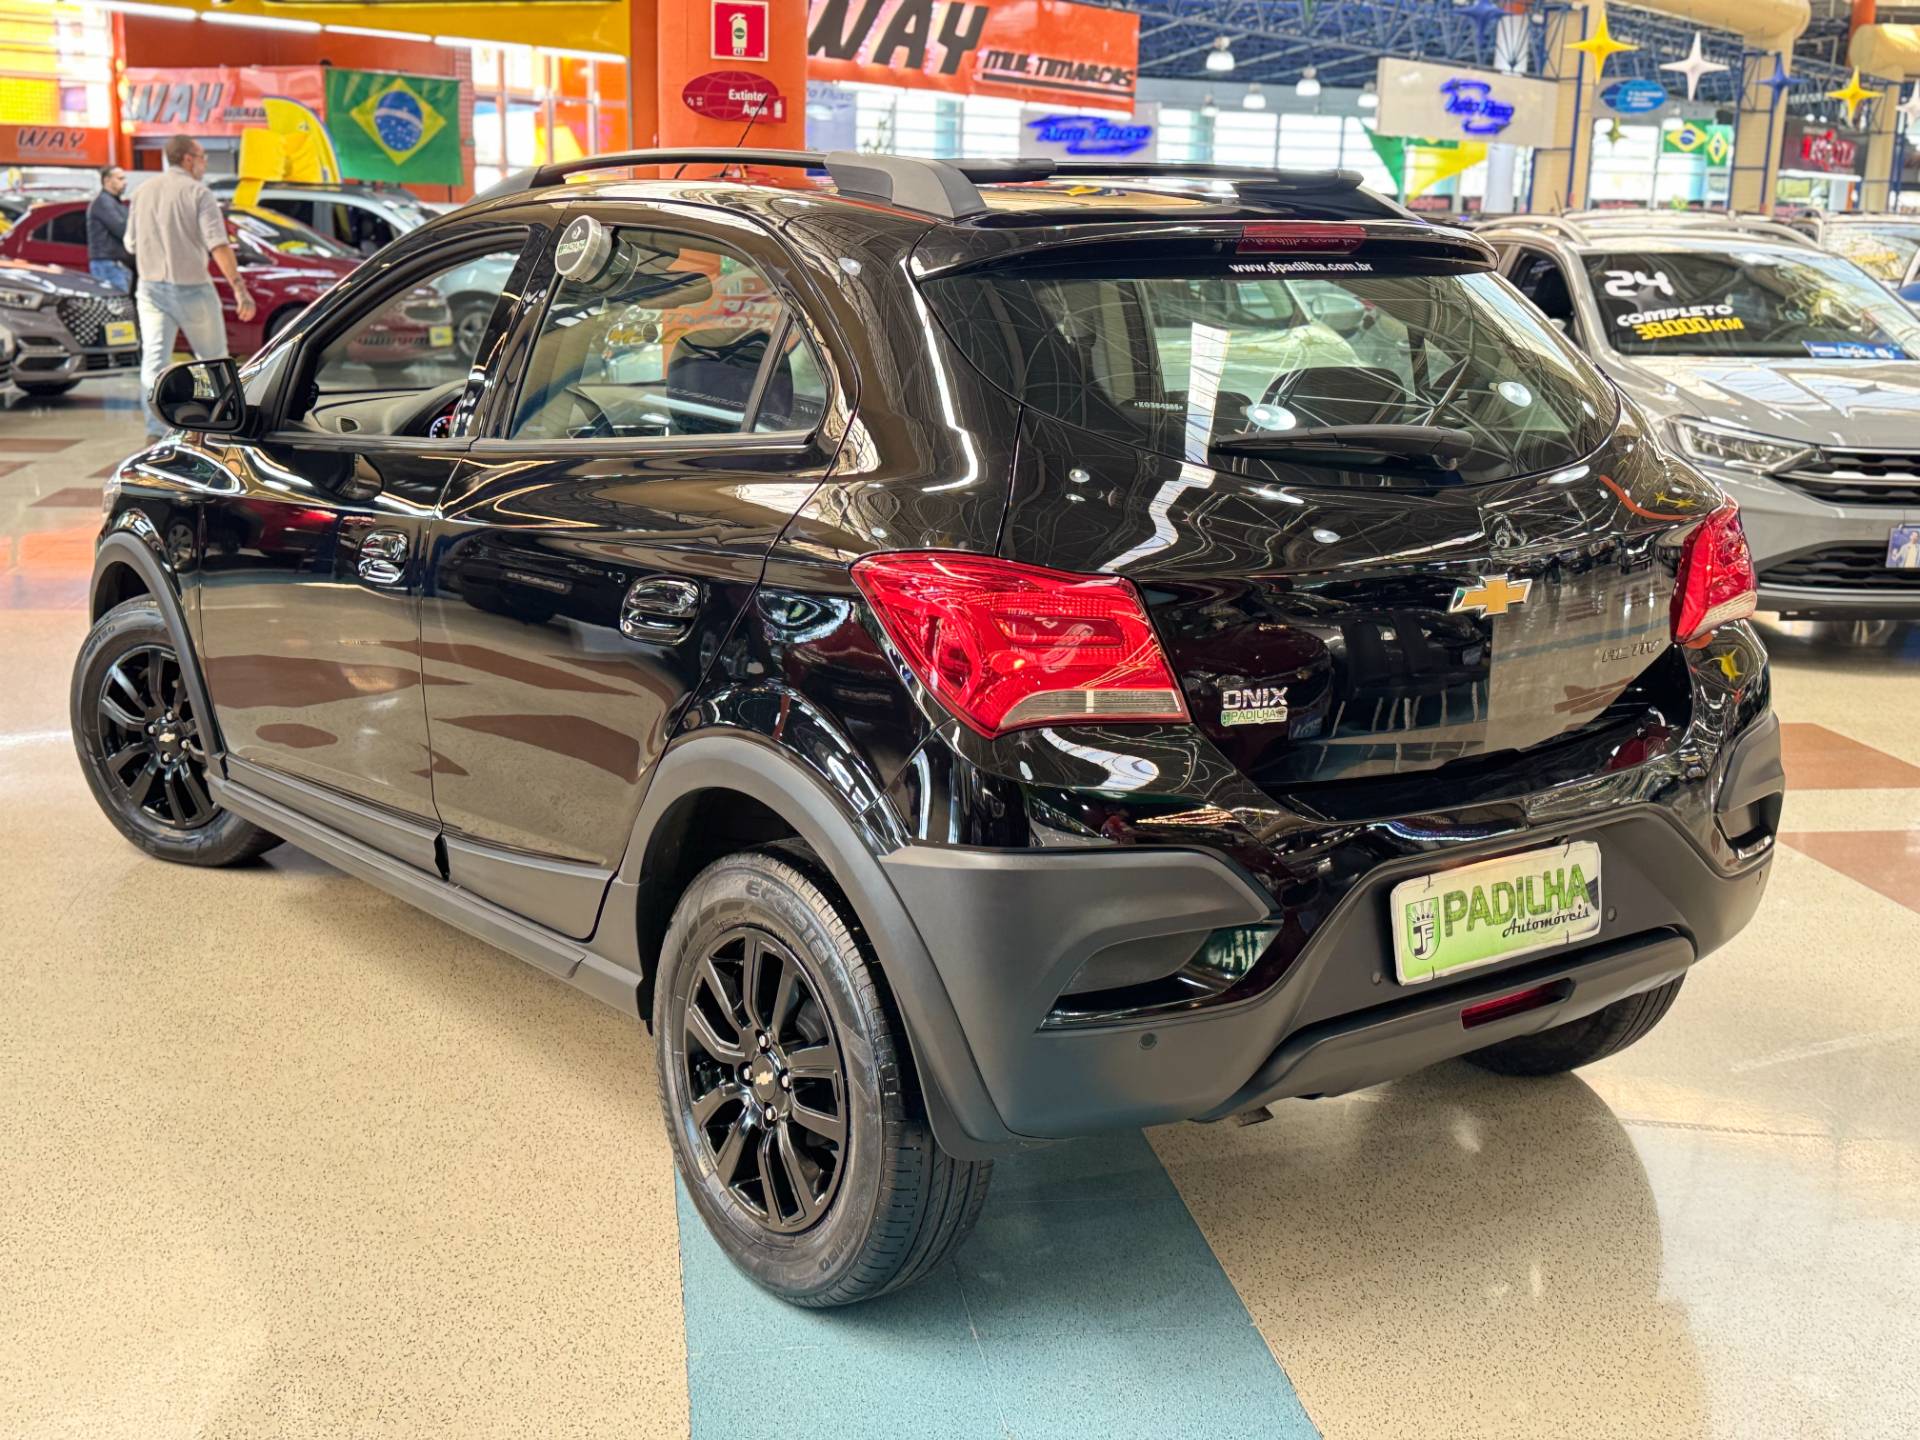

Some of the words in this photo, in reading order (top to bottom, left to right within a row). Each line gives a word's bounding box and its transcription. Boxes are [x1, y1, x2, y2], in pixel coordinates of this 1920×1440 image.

[806, 0, 989, 75] WAY
[126, 83, 224, 123] WAY
[728, 88, 768, 102] Extintor
[742, 101, 769, 117] Água
[17, 126, 85, 149] WAY
[1603, 270, 1674, 297] 24
[1616, 304, 1734, 327] COMPLETO
[1222, 686, 1289, 709] ONIX
[1231, 708, 1276, 720] PADILHA
[1443, 863, 1591, 938] PADILHA
[1501, 904, 1591, 939] Automóveis
